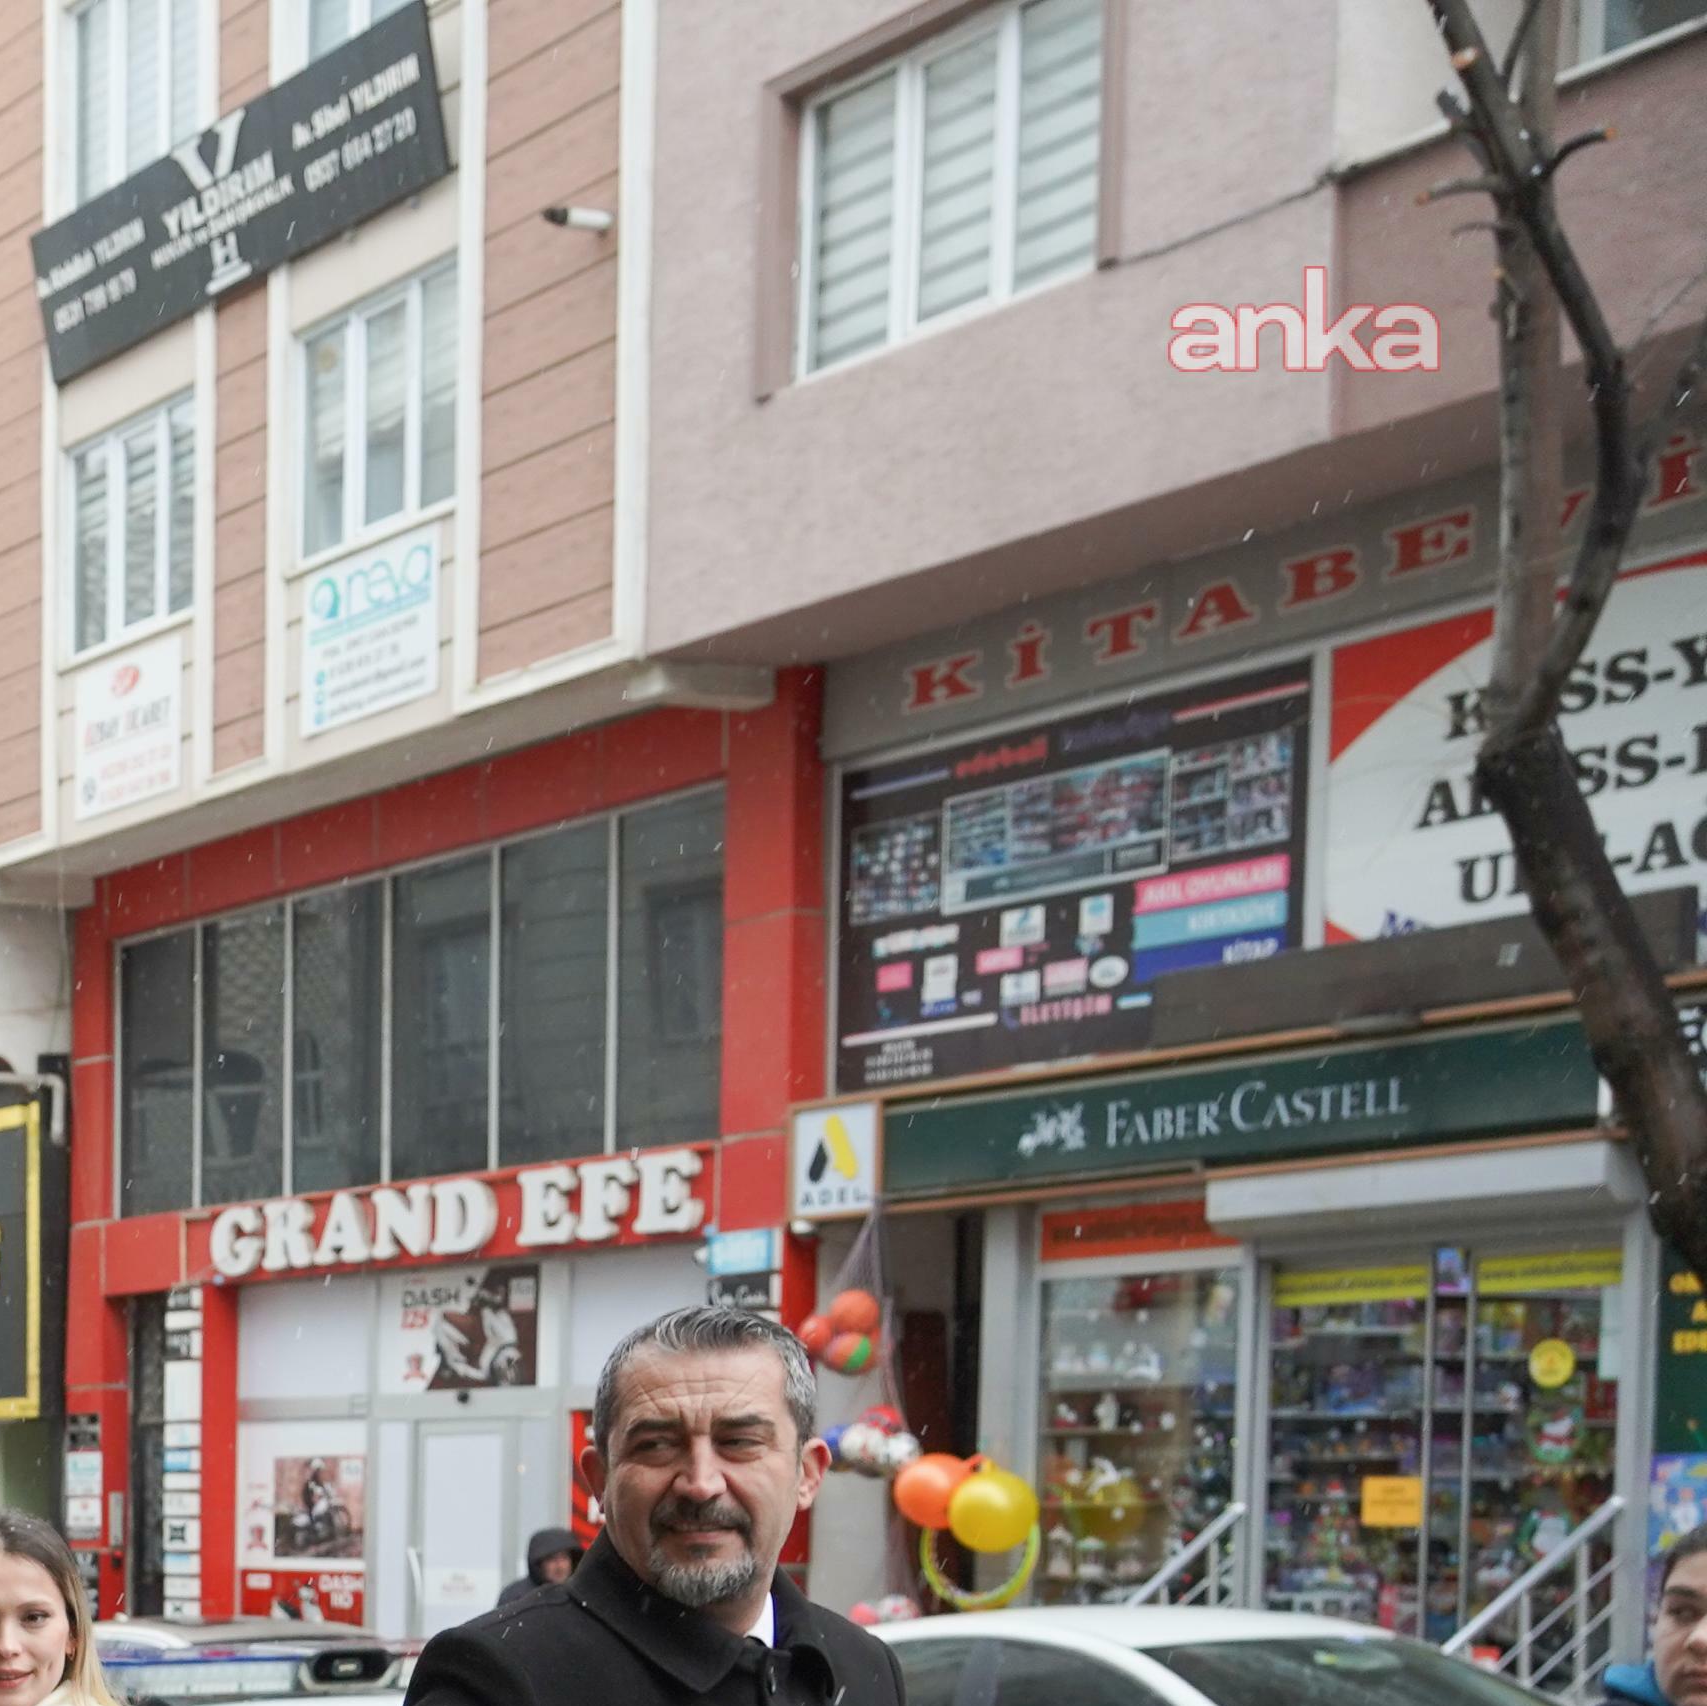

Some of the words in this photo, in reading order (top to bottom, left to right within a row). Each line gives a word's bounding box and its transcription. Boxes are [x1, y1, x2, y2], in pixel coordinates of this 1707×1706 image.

[162, 151, 276, 240] YILDIRIM
[209, 1177, 499, 1278] GRAND
[516, 1150, 706, 1248] EFE
[402, 1287, 461, 1309] DASH
